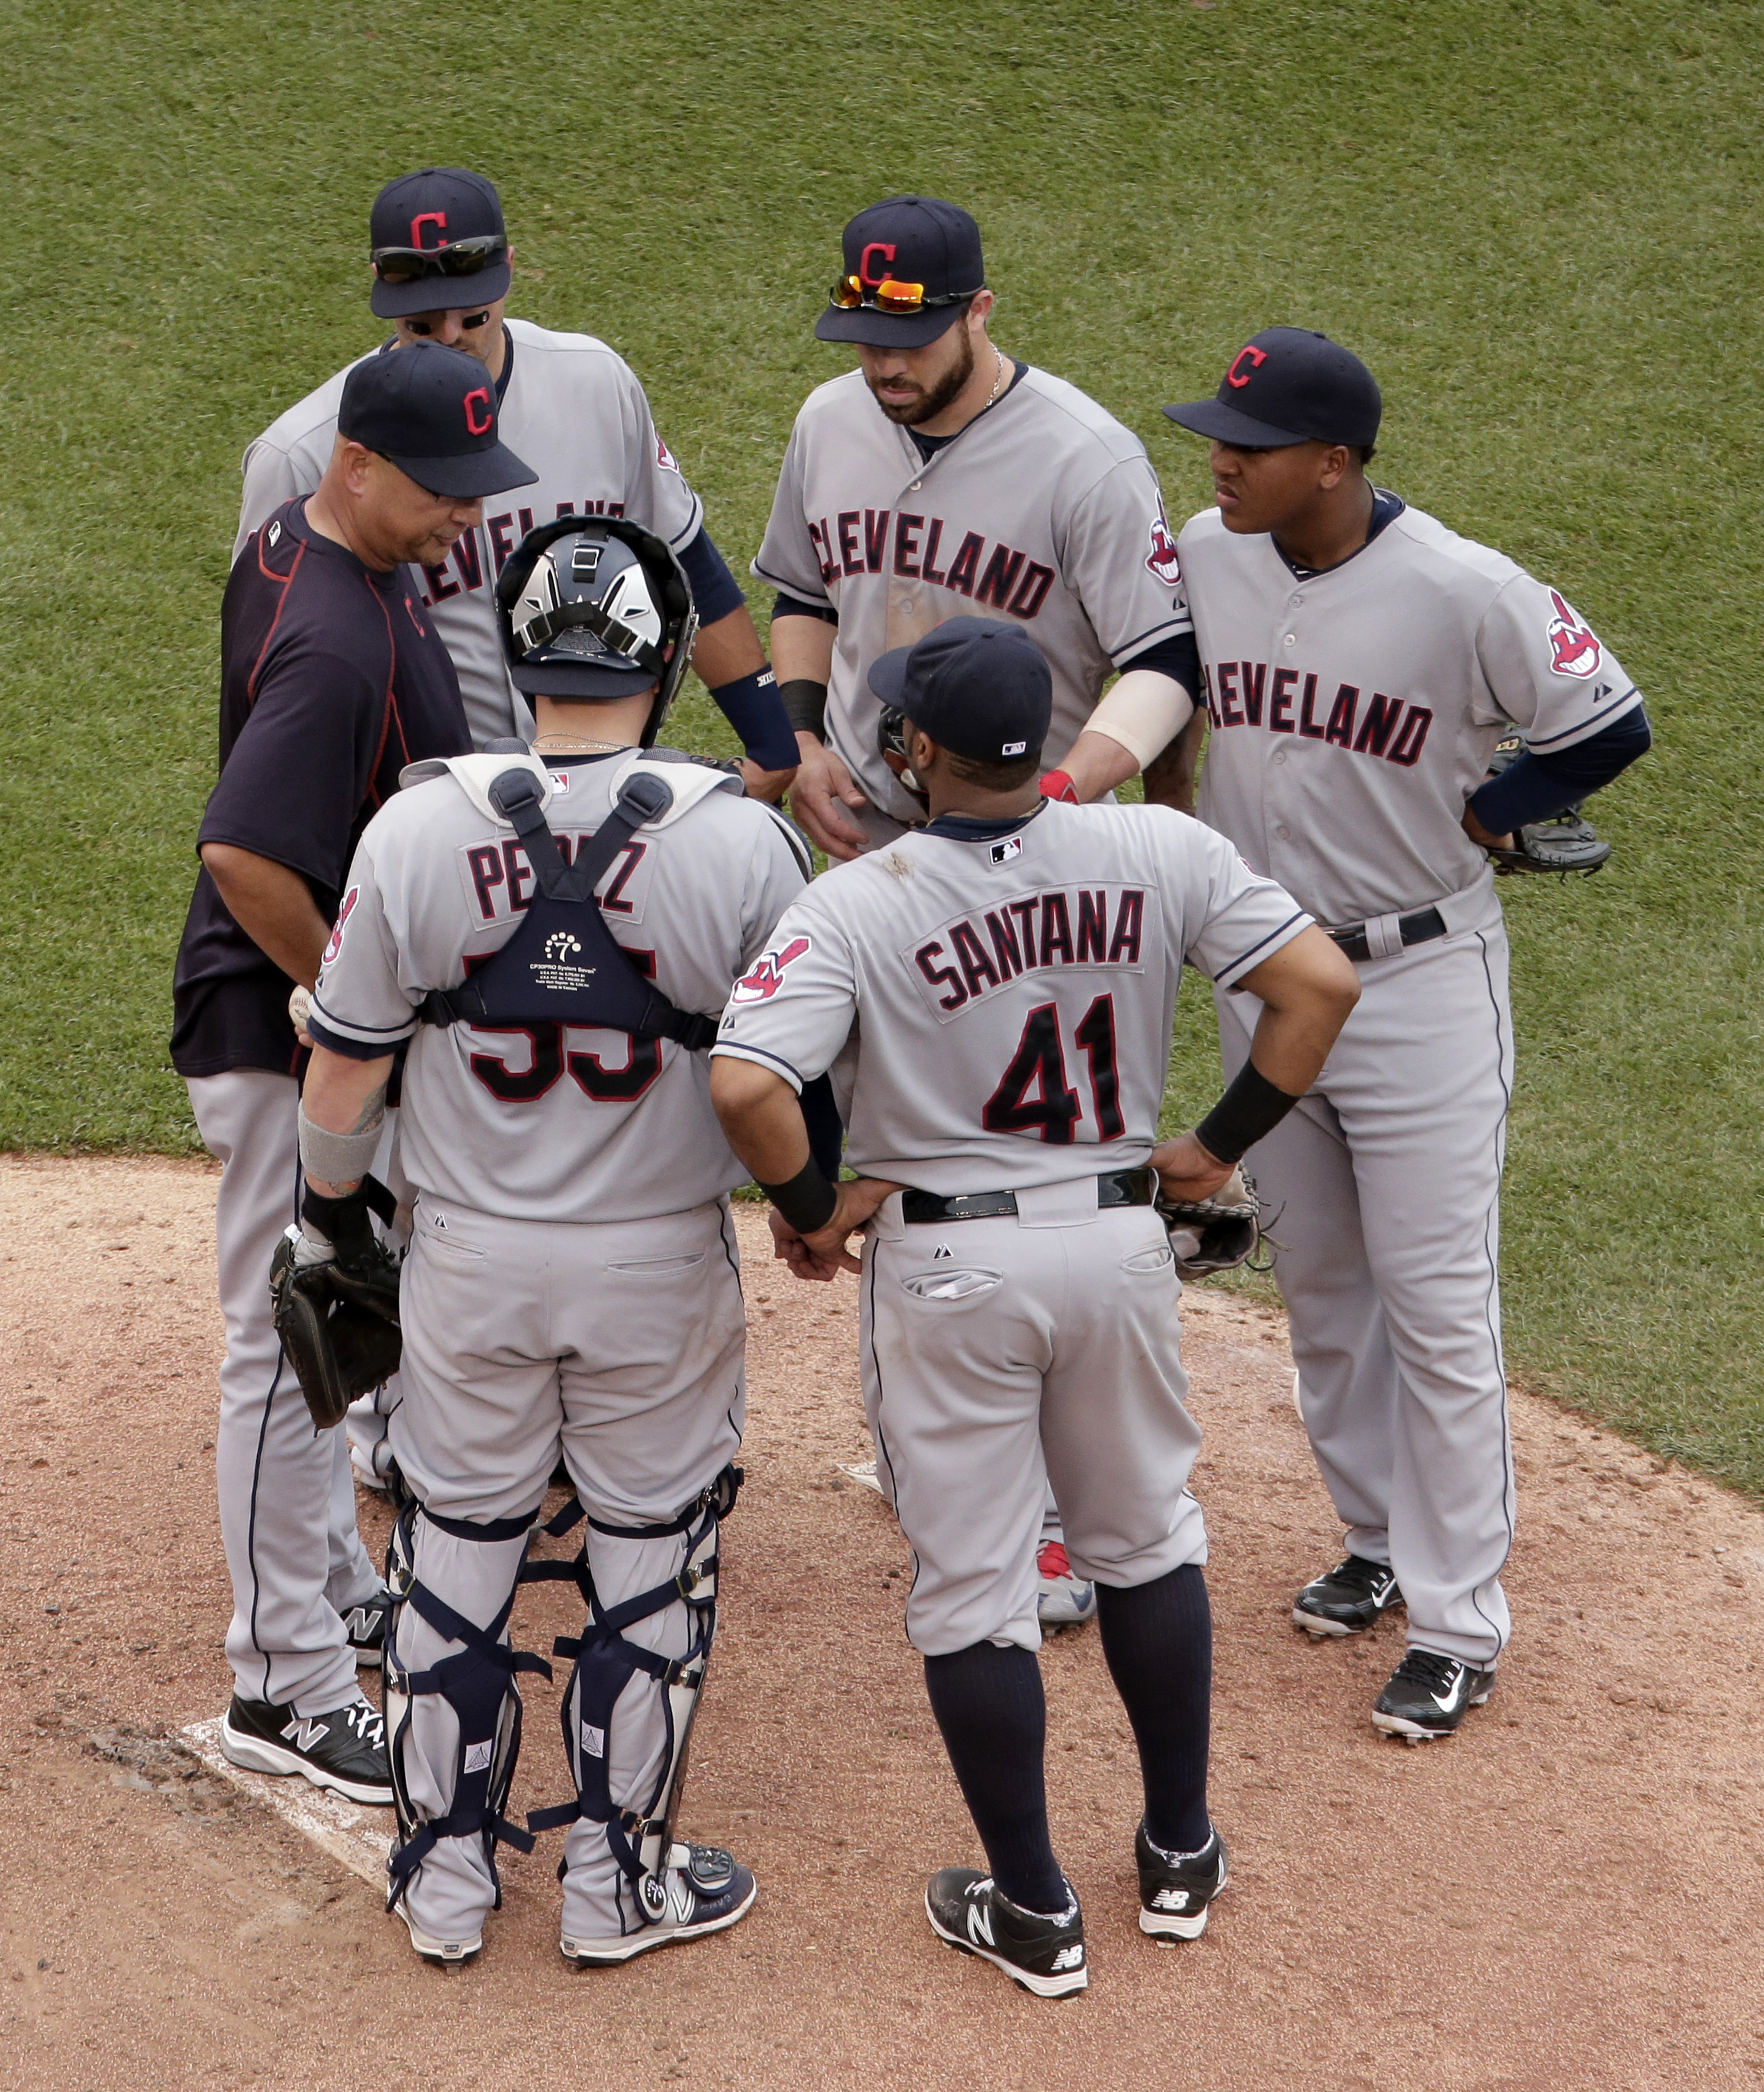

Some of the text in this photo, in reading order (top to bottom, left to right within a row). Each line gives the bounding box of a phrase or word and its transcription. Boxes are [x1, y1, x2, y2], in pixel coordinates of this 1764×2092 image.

[410, 212, 448, 250] C
[860, 242, 897, 287] C
[1225, 344, 1268, 390] C
[463, 387, 492, 435] C
[808, 508, 1056, 620] CLEVELAND
[1204, 661, 1433, 767] LEVELAND
[467, 834, 647, 920] PEZ
[554, 941, 570, 963] 7
[915, 890, 1145, 1011] SANTANA
[982, 993, 1126, 1145] 41
[344, 1607, 383, 1641] N
[280, 1718, 330, 1752] N
[967, 1904, 995, 1946] N
